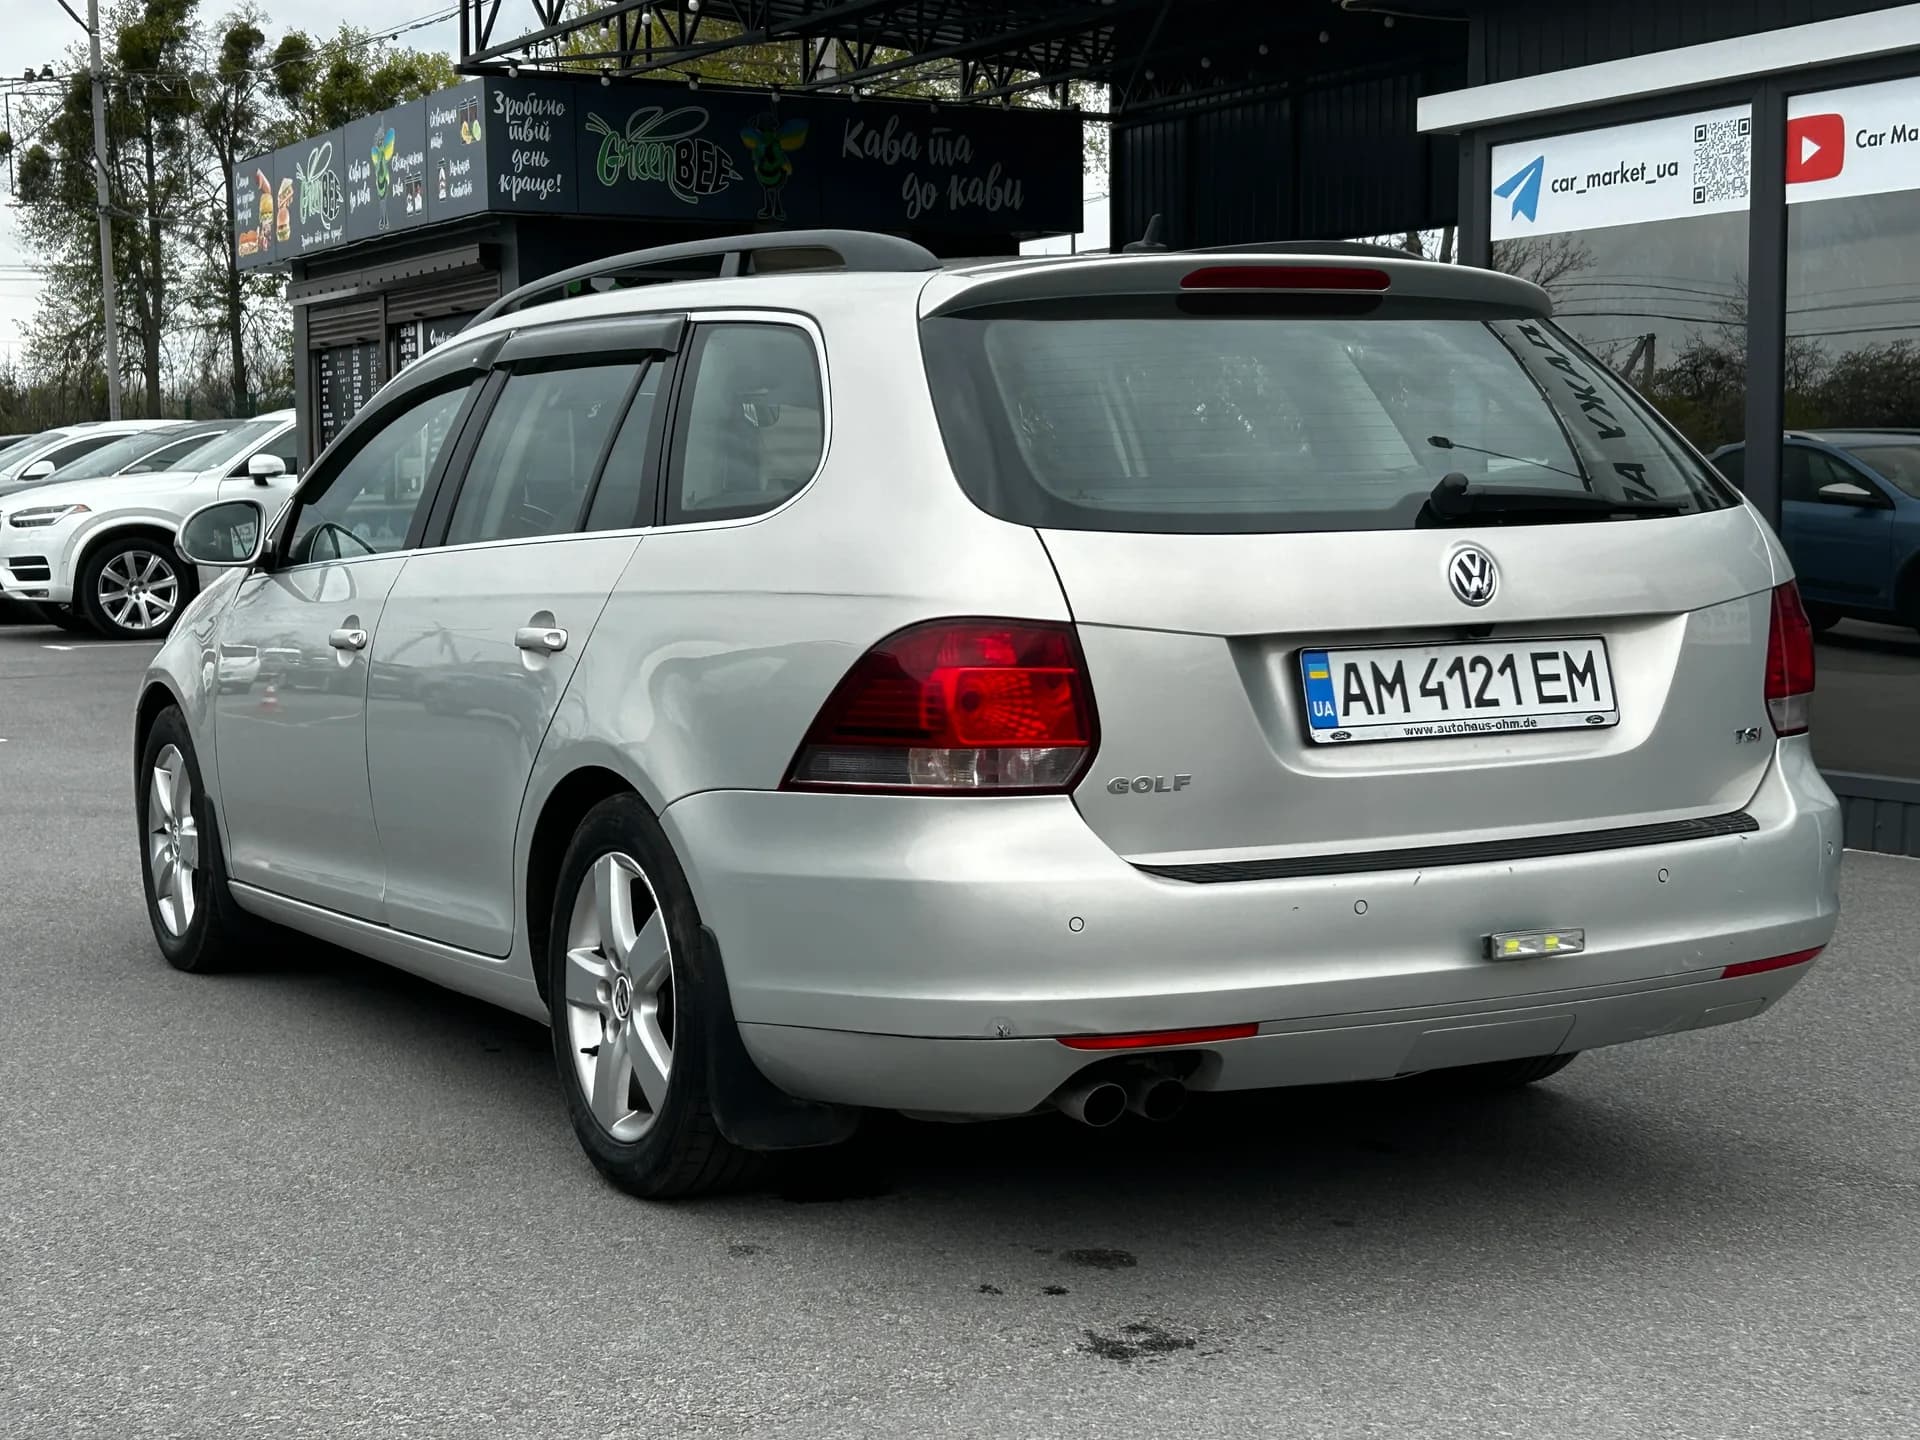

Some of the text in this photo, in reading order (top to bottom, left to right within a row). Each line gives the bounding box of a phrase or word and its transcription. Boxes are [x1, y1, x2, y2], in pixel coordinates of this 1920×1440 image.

[493, 90, 566, 123] Зробимо
[508, 116, 551, 142] твій
[842, 114, 975, 166] Кава та
[1855, 129, 1887, 148] Car
[511, 148, 551, 173] день
[499, 173, 562, 202] краще!
[902, 162, 1025, 220] до кави
[1551, 160, 1679, 195] car_market_ua
[1342, 650, 1601, 717] AM 4121 EM
[1313, 701, 1335, 718] UA
[1403, 718, 1538, 736] www.autohaus-ohm.de
[1107, 773, 1192, 795] GOLF
